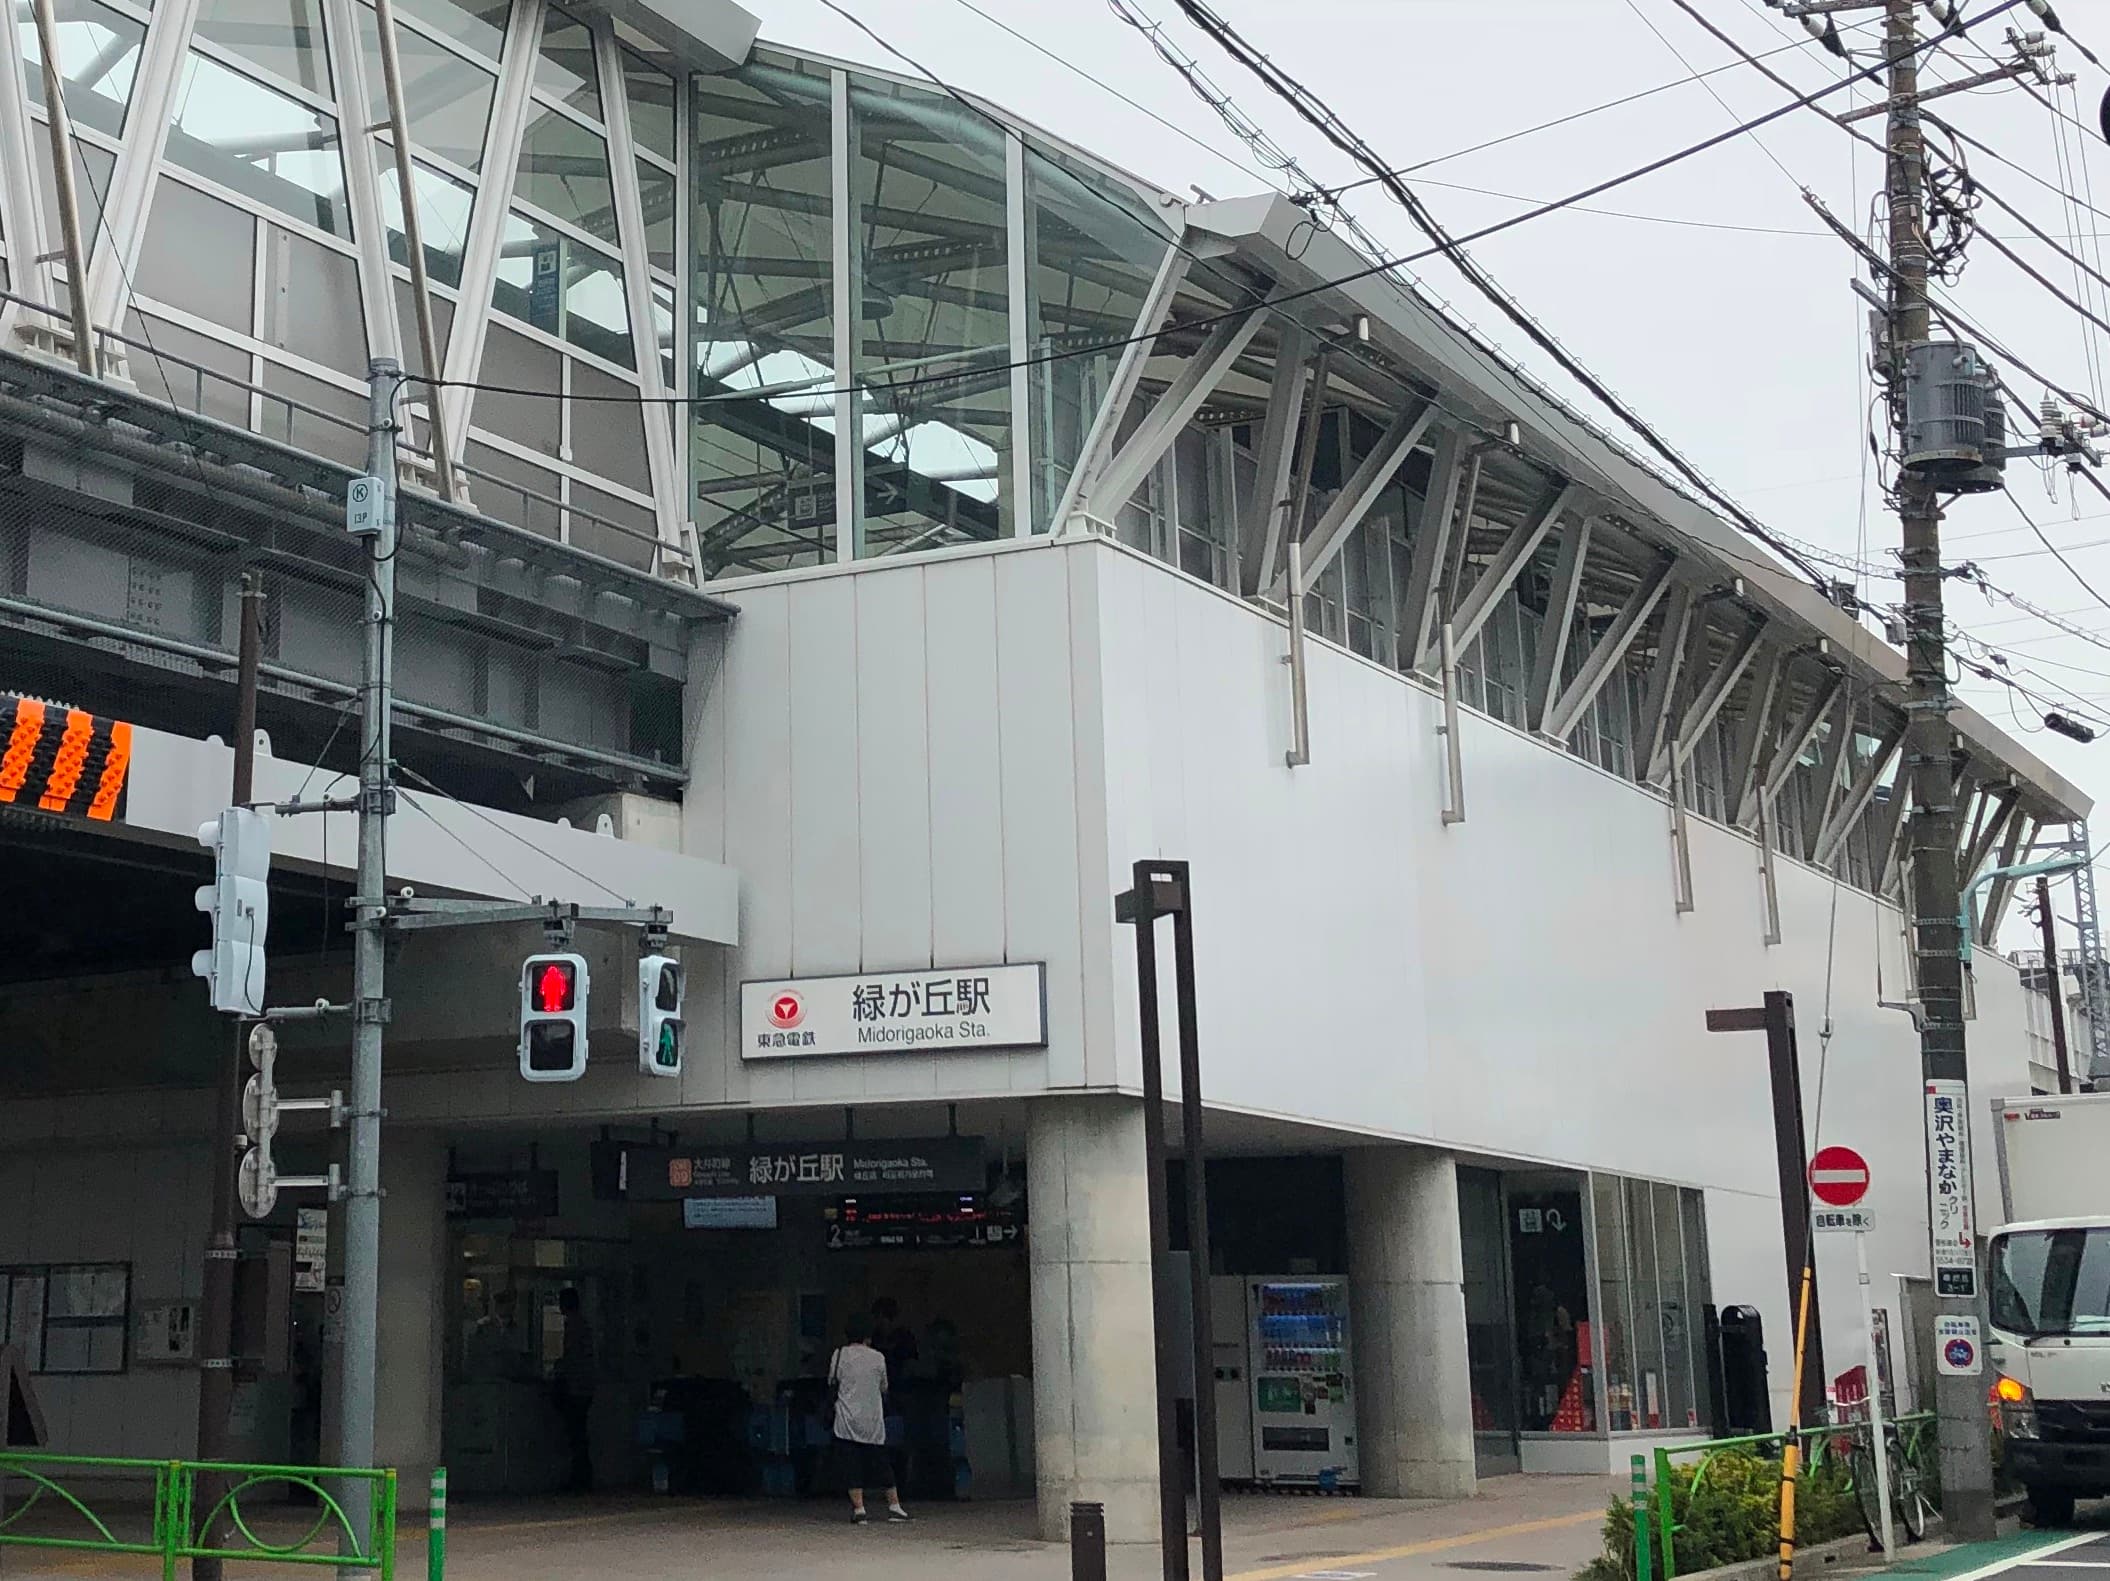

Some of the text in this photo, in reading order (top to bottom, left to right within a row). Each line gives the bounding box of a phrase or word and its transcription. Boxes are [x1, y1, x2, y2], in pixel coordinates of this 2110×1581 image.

[852, 977, 991, 1022] 緑が丘駅
[757, 1030, 817, 1049] 東急電鉄
[857, 1020, 991, 1045] Midorigaoka Sta.
[1934, 1097, 1958, 1195] 奥沢やまなか
[749, 1153, 845, 1185] 緑が丘駅
[1815, 1213, 1870, 1227] 自転車を除く
